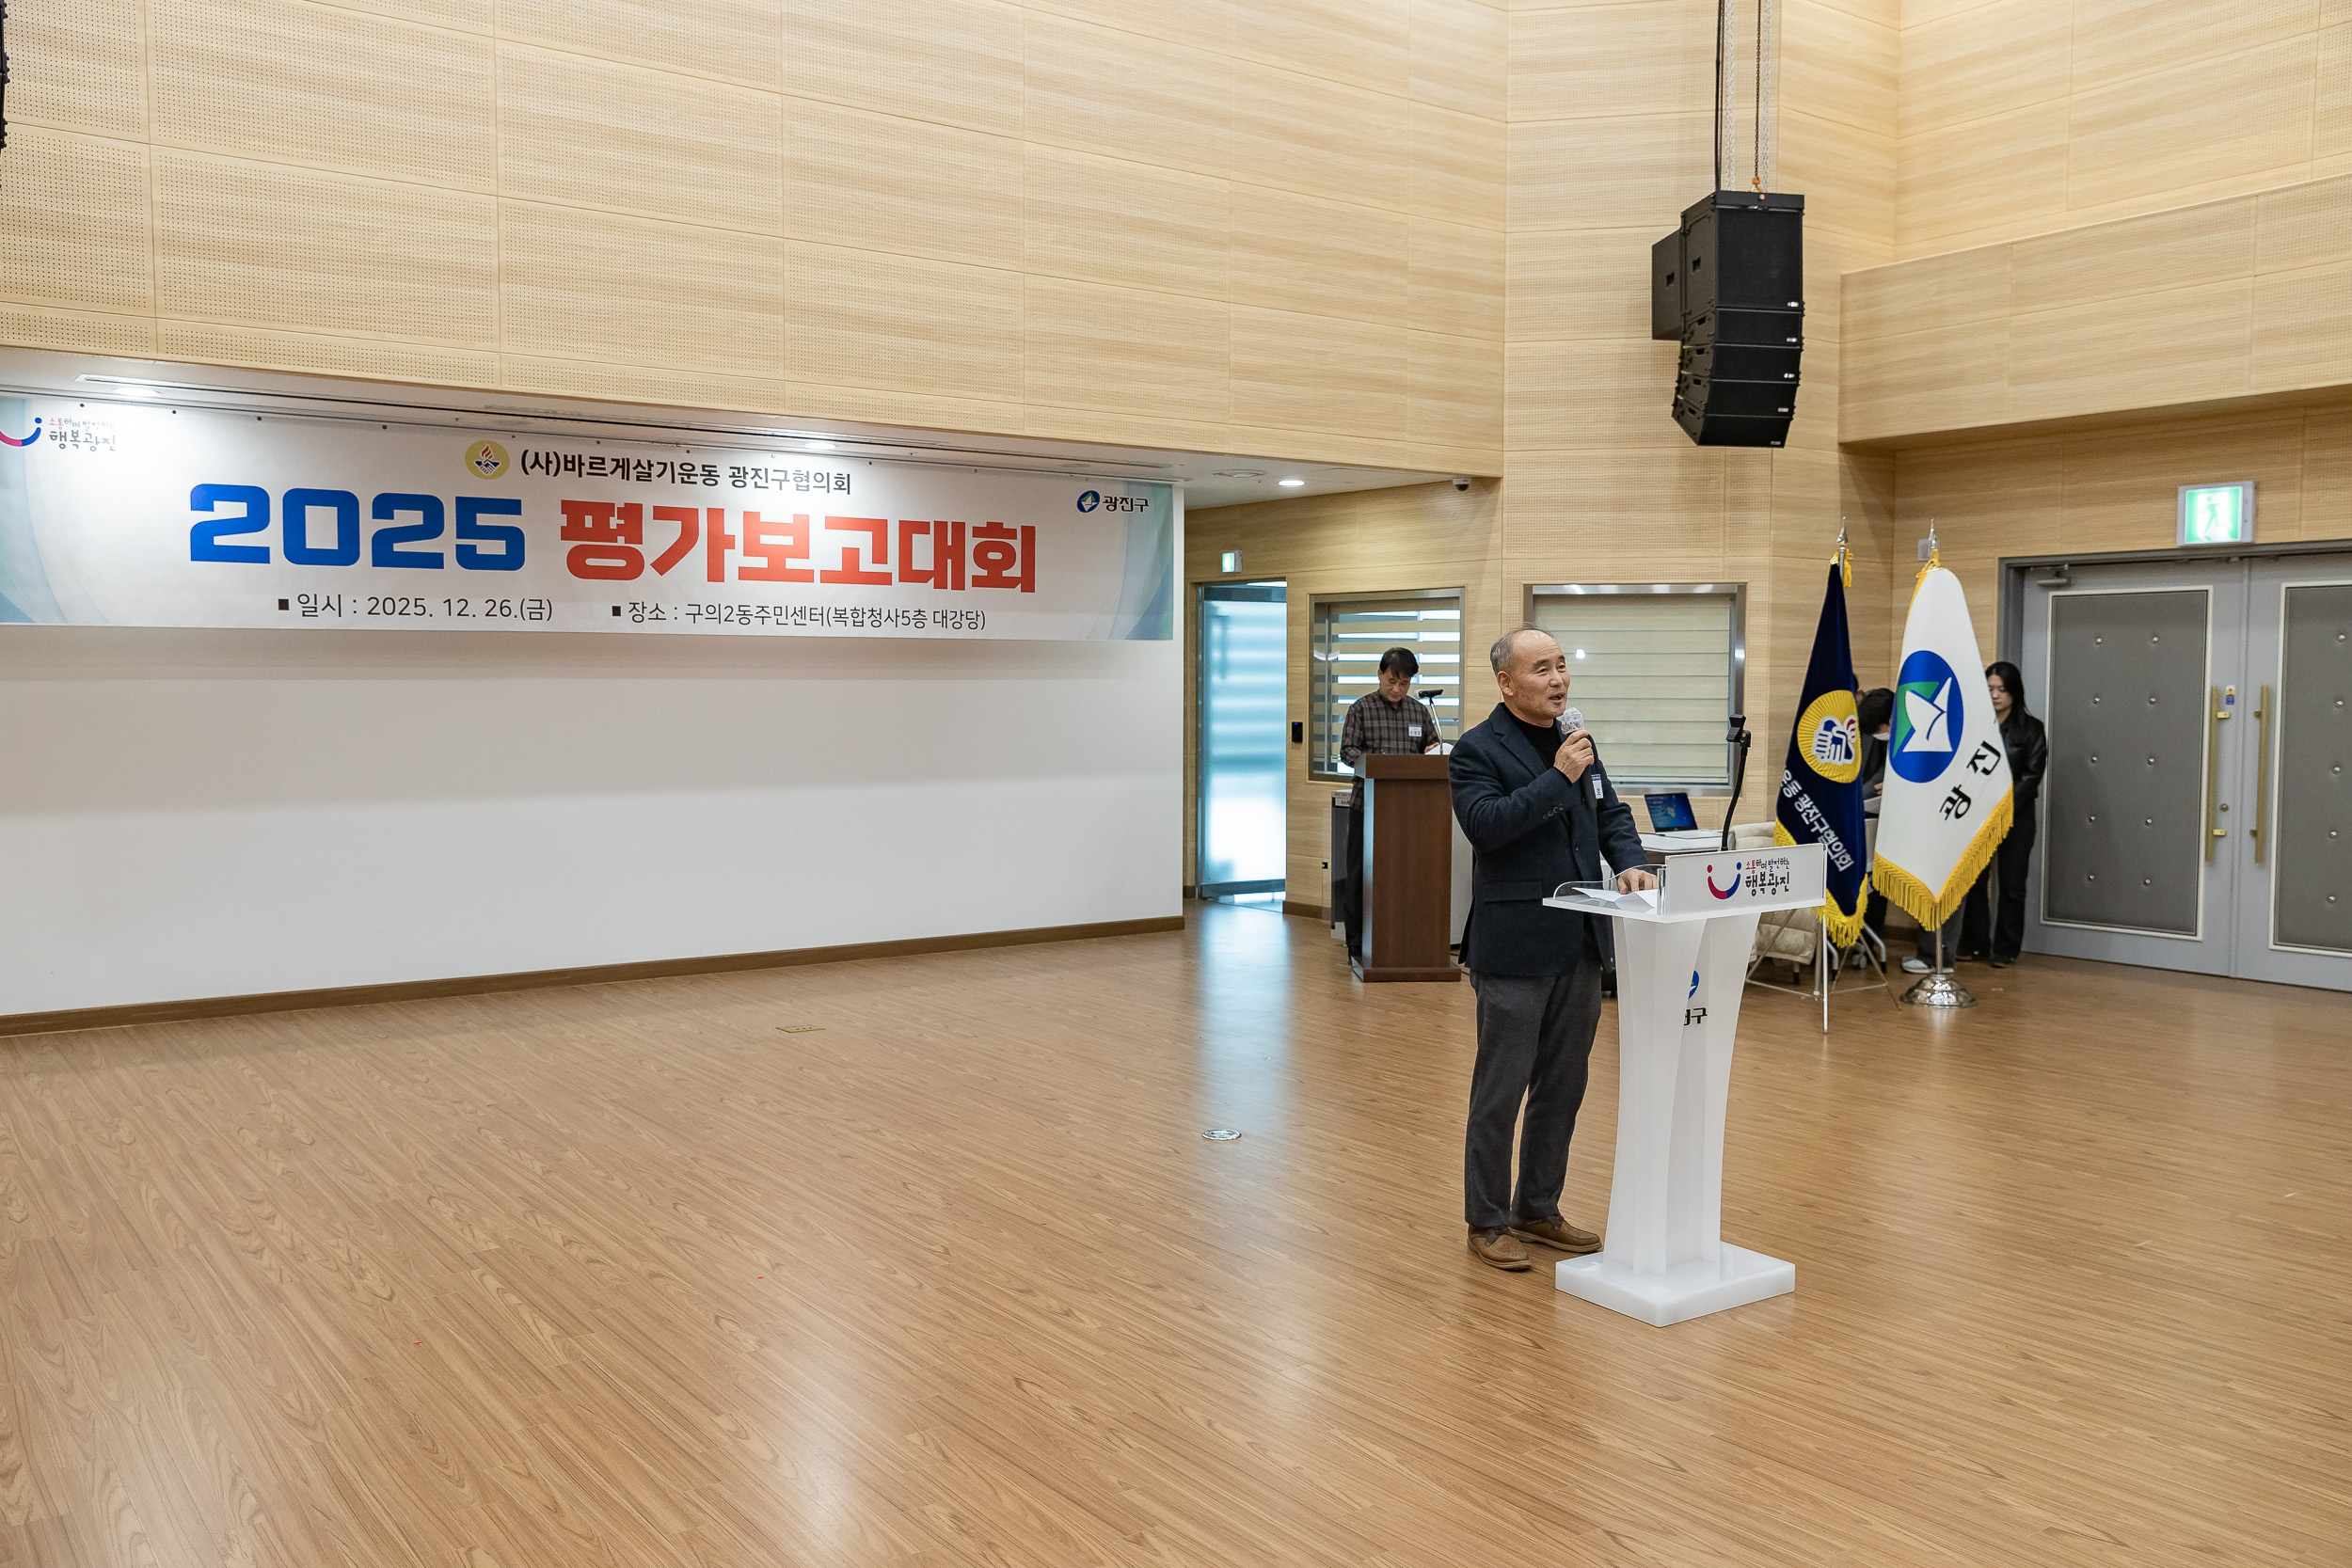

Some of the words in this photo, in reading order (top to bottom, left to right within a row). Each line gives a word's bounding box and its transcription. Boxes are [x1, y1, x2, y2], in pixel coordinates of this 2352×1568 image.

[49, 431, 117, 452] 행복광진
[521, 449, 721, 486] (사)바르게살기운동
[728, 465, 851, 495] 광진구협의회
[1103, 496, 1150, 513] 광진구
[190, 483, 525, 571] 2025
[561, 499, 1036, 594] 평가보고대회
[296, 594, 342, 618] 일시
[367, 596, 434, 618] 2025.
[442, 598, 477, 619] 12.
[485, 598, 553, 622] 26.(금)
[628, 601, 667, 623] 장소
[685, 603, 929, 629] 구의2동주민센터(복합청사5층
[933, 608, 987, 630] 대강당)
[1794, 793, 1854, 872] 광진구협의회
[1745, 871, 1789, 896] 행복광진
